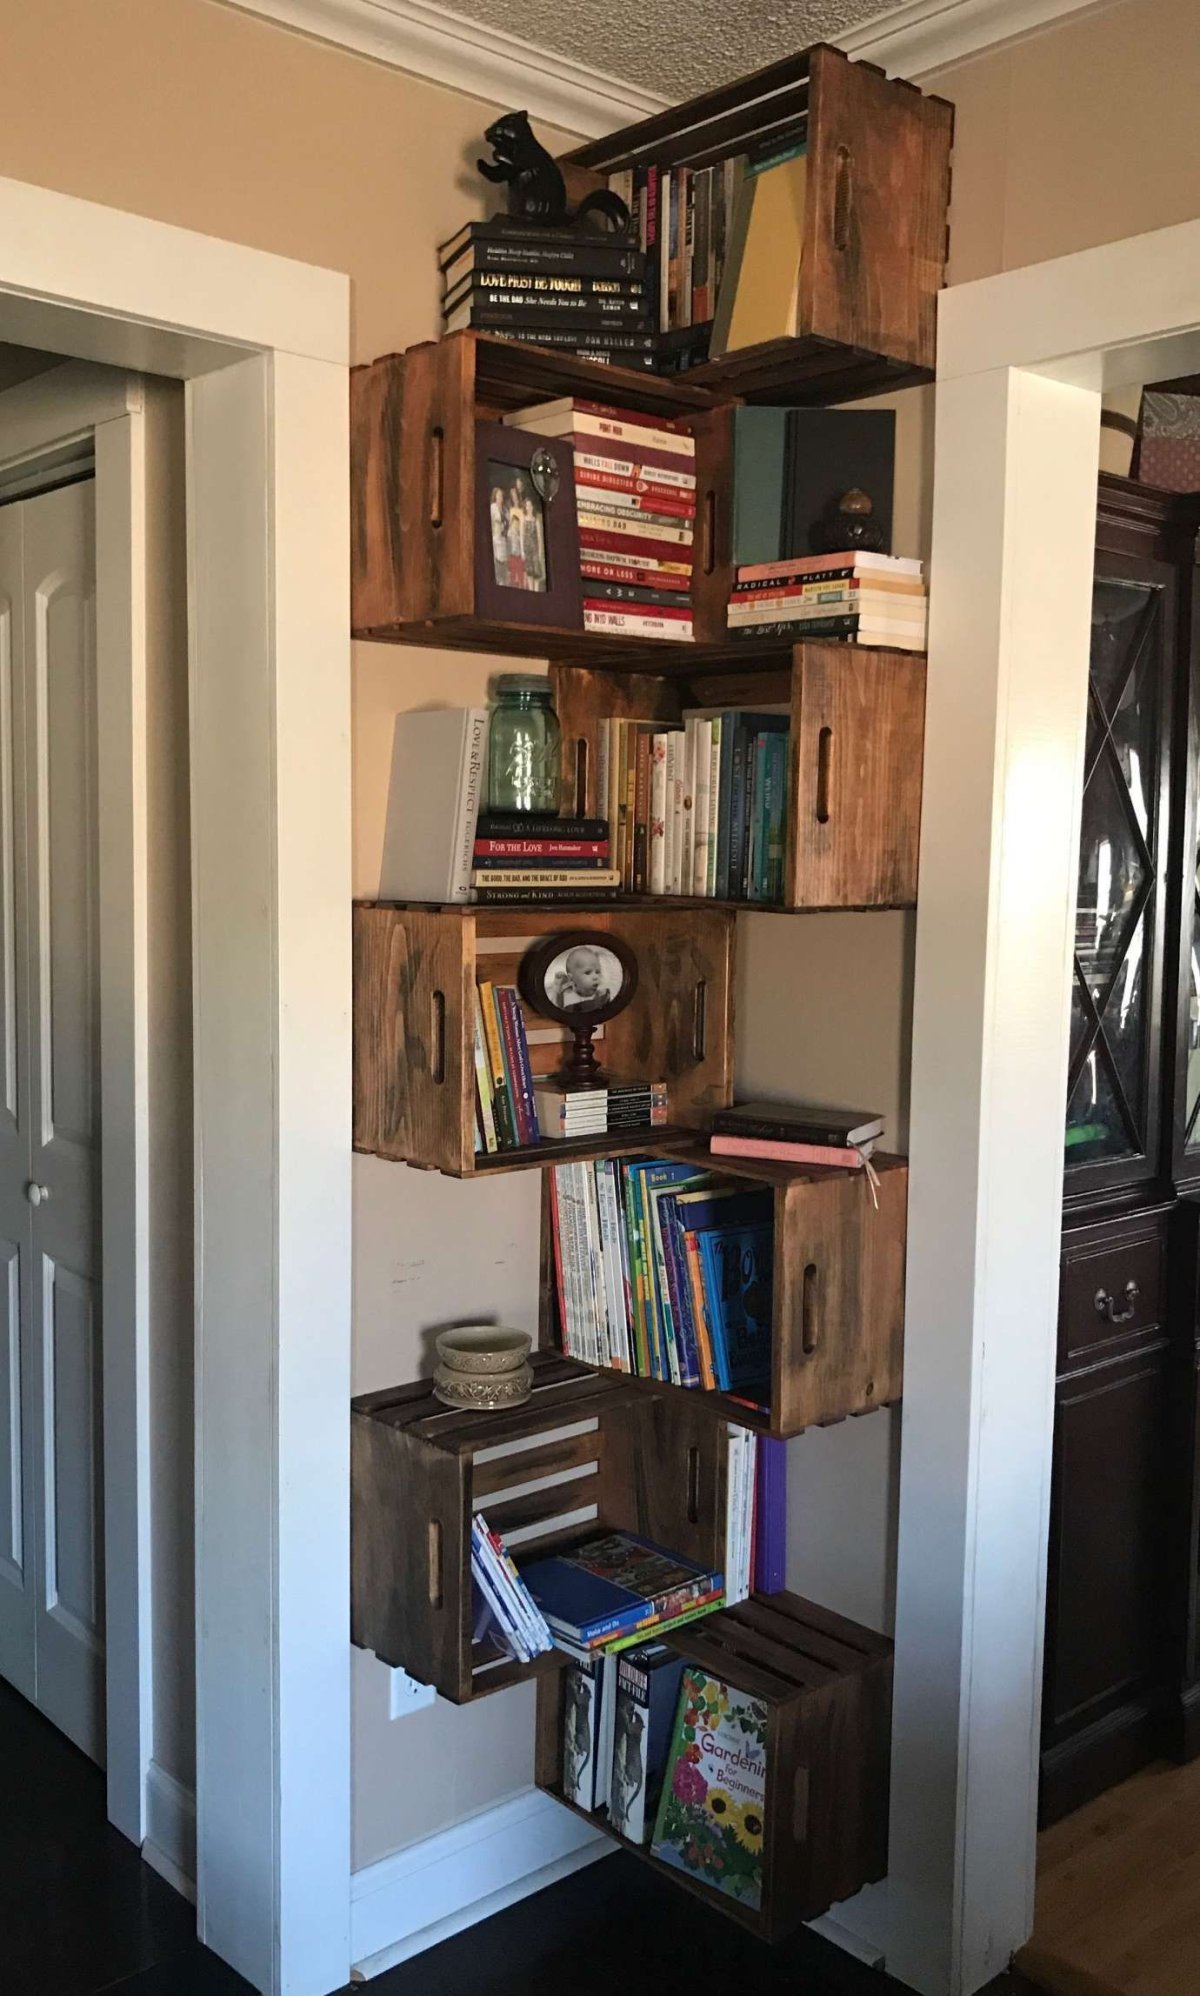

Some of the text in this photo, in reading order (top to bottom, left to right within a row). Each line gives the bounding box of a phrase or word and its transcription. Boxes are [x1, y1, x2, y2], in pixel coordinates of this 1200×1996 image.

[480, 273, 506, 287] LOVE
[508, 275, 531, 289] MUST
[549, 277, 582, 292] TOUGH
[490, 294, 498, 302] BE
[499, 295, 511, 303] THE
[513, 295, 524, 304] DAD
[524, 295, 538, 305] She
[538, 297, 557, 306] Needs
[558, 298, 569, 307] You
[585, 336, 635, 347] DAN MILLER
[614, 462, 630, 472] DOWN
[577, 501, 652, 520] EMBRACING OBSCURITY
[580, 564, 634, 580] MORE OR LESS
[736, 572, 837, 591] RADICAL PLATT
[471, 718, 485, 750] LOVE
[471, 750, 480, 763] &
[466, 760, 481, 815] RESPECT
[489, 840, 506, 852] FOR
[506, 843, 521, 852] THE
[523, 841, 543, 852] LOVE
[731, 821, 739, 870] MIDDLE
[482, 874, 490, 882] THE
[503, 874, 511, 882] THE
[522, 874, 530, 882] AND
[531, 874, 539, 882] THE
[540, 874, 553, 882] GRACE
[553, 874, 559, 882] OF
[559, 874, 568, 882] GOD
[486, 890, 520, 899] STRONG
[520, 891, 531, 899] and
[532, 890, 554, 899] KIND
[513, 1020, 521, 1038] Woman
[651, 1173, 668, 1183] Book
[602, 1623, 612, 1632] and
[716, 1768, 765, 1801] Beginners
